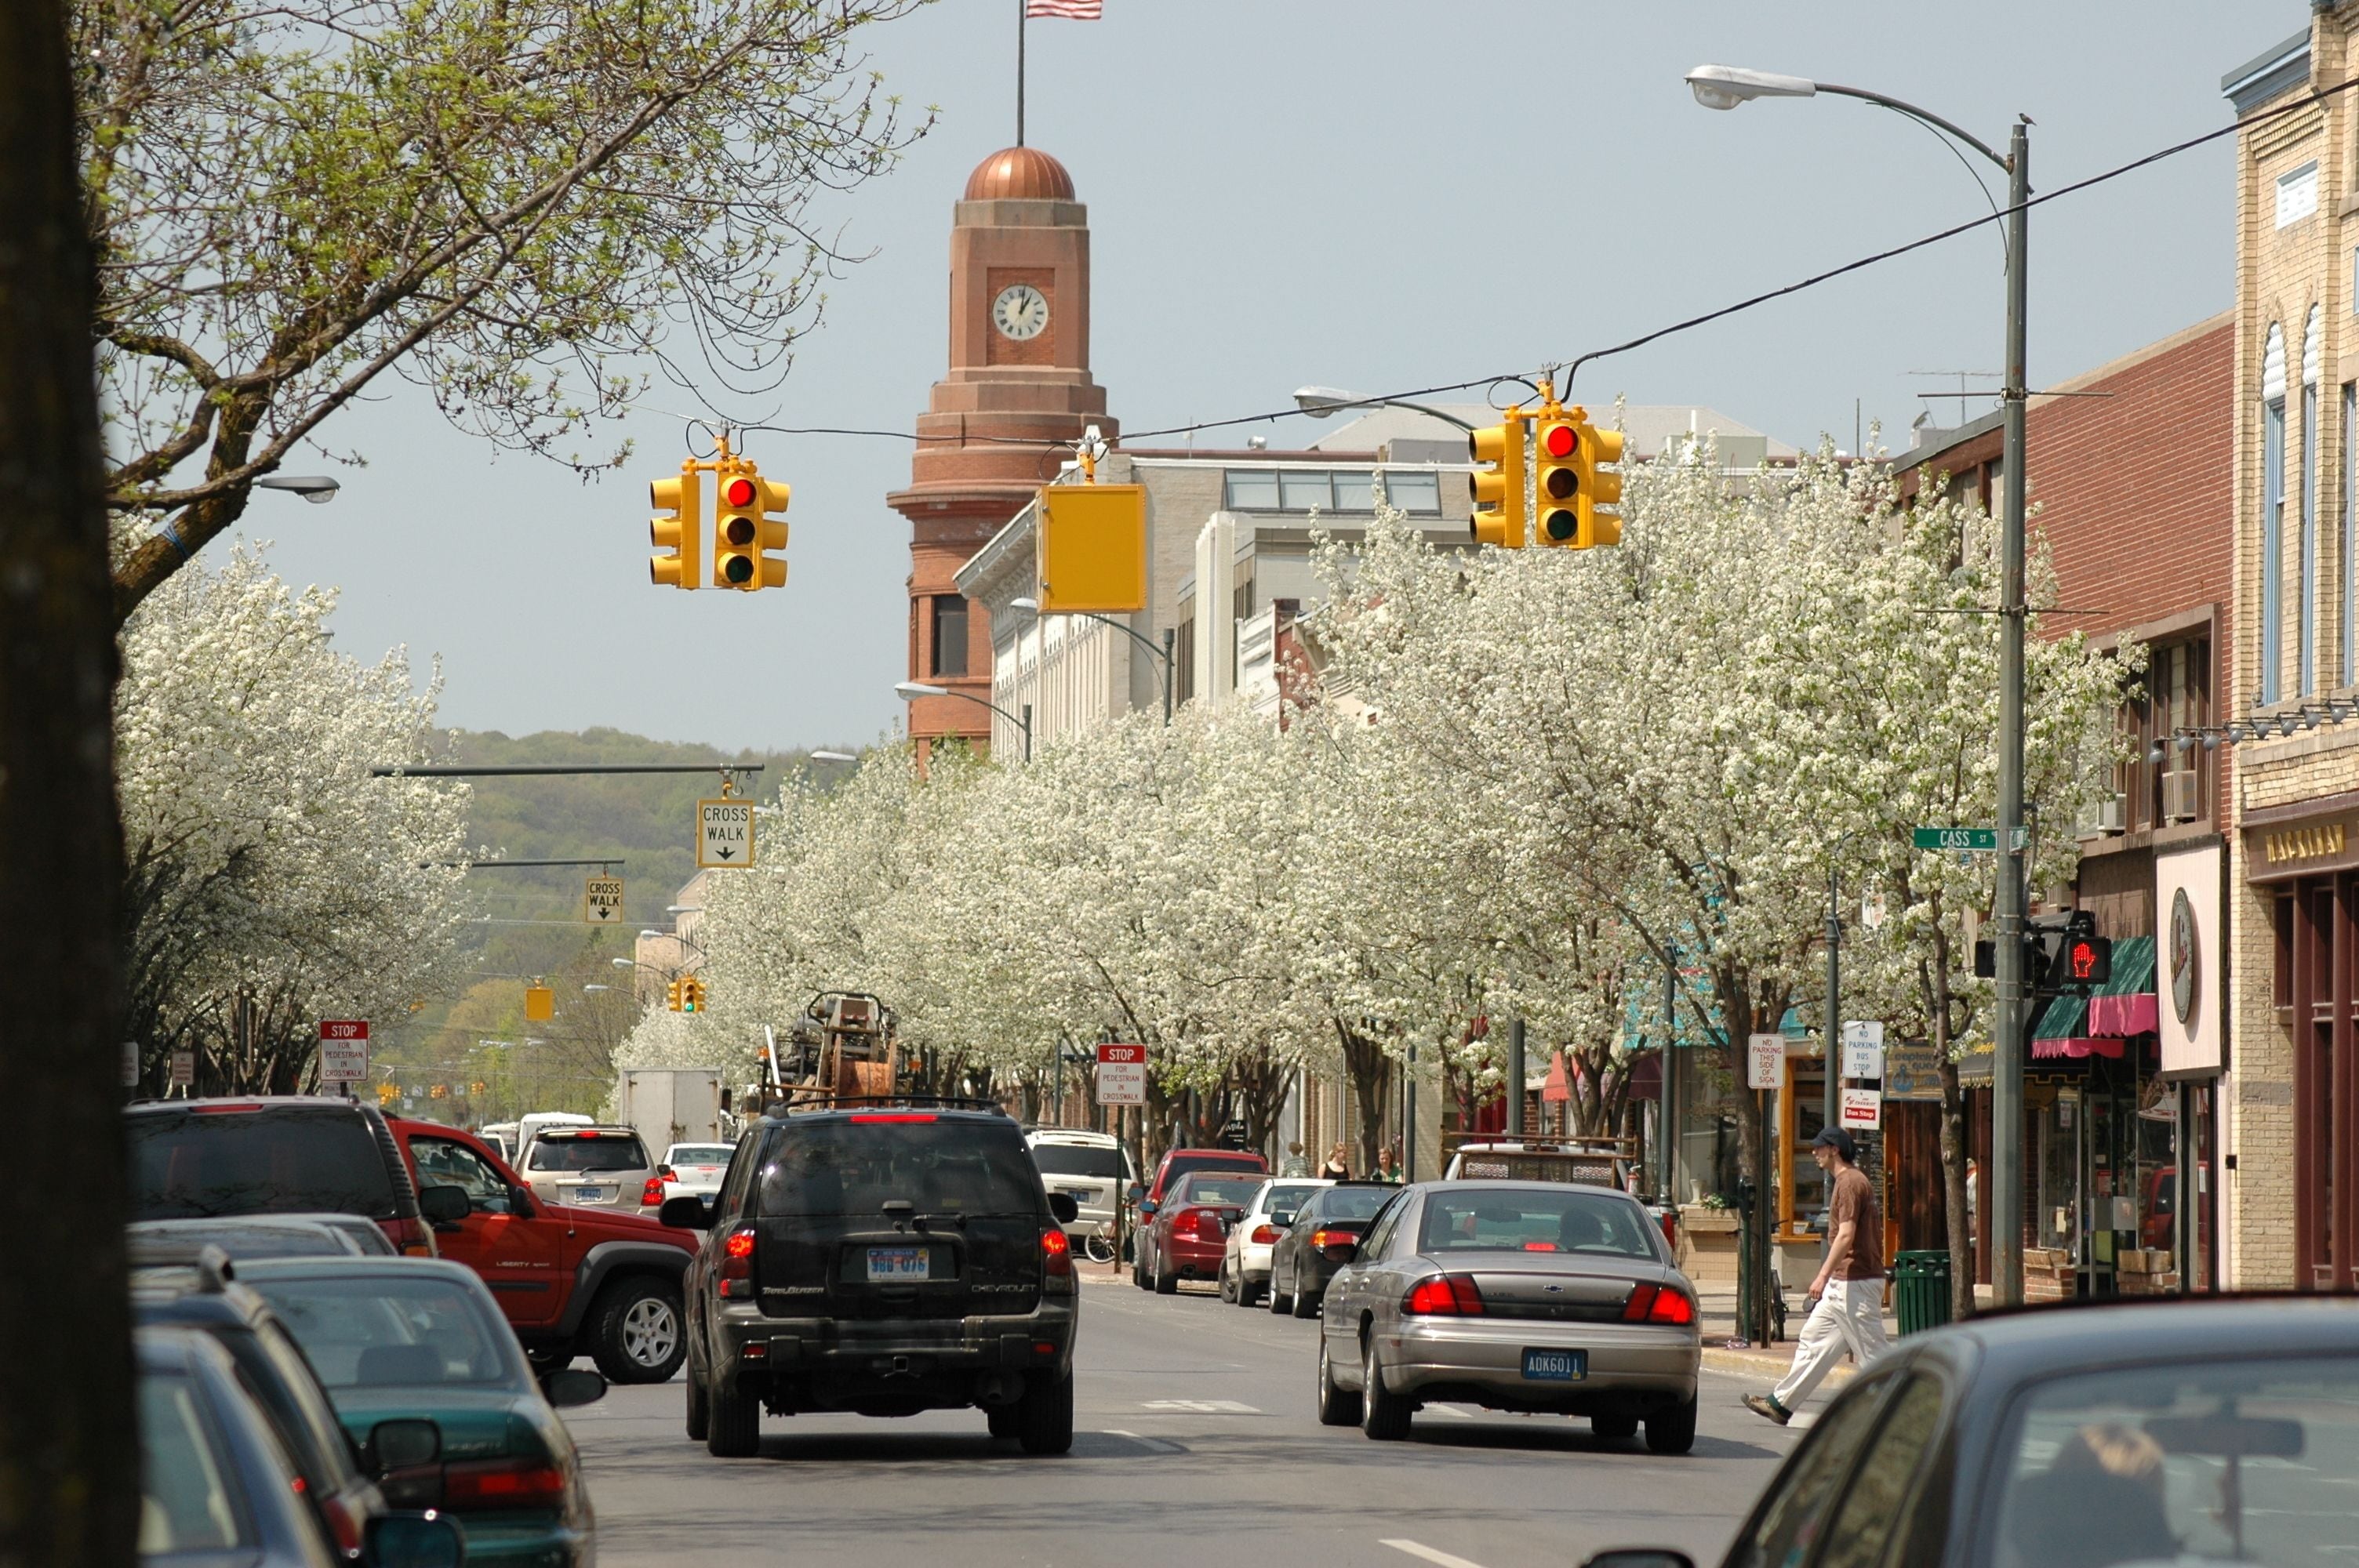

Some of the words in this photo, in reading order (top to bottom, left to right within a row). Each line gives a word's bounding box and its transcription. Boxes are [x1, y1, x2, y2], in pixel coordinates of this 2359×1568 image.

[703, 808, 748, 822] CROSS
[707, 827, 744, 840] WALK
[1939, 830, 1970, 847] CASS
[1979, 835, 1987, 844] ST
[589, 883, 620, 894] CROSS
[589, 895, 620, 906] WALK
[331, 1025, 358, 1037] STOP
[1109, 1049, 1134, 1061] STOP
[1859, 1110, 1874, 1119] Stop
